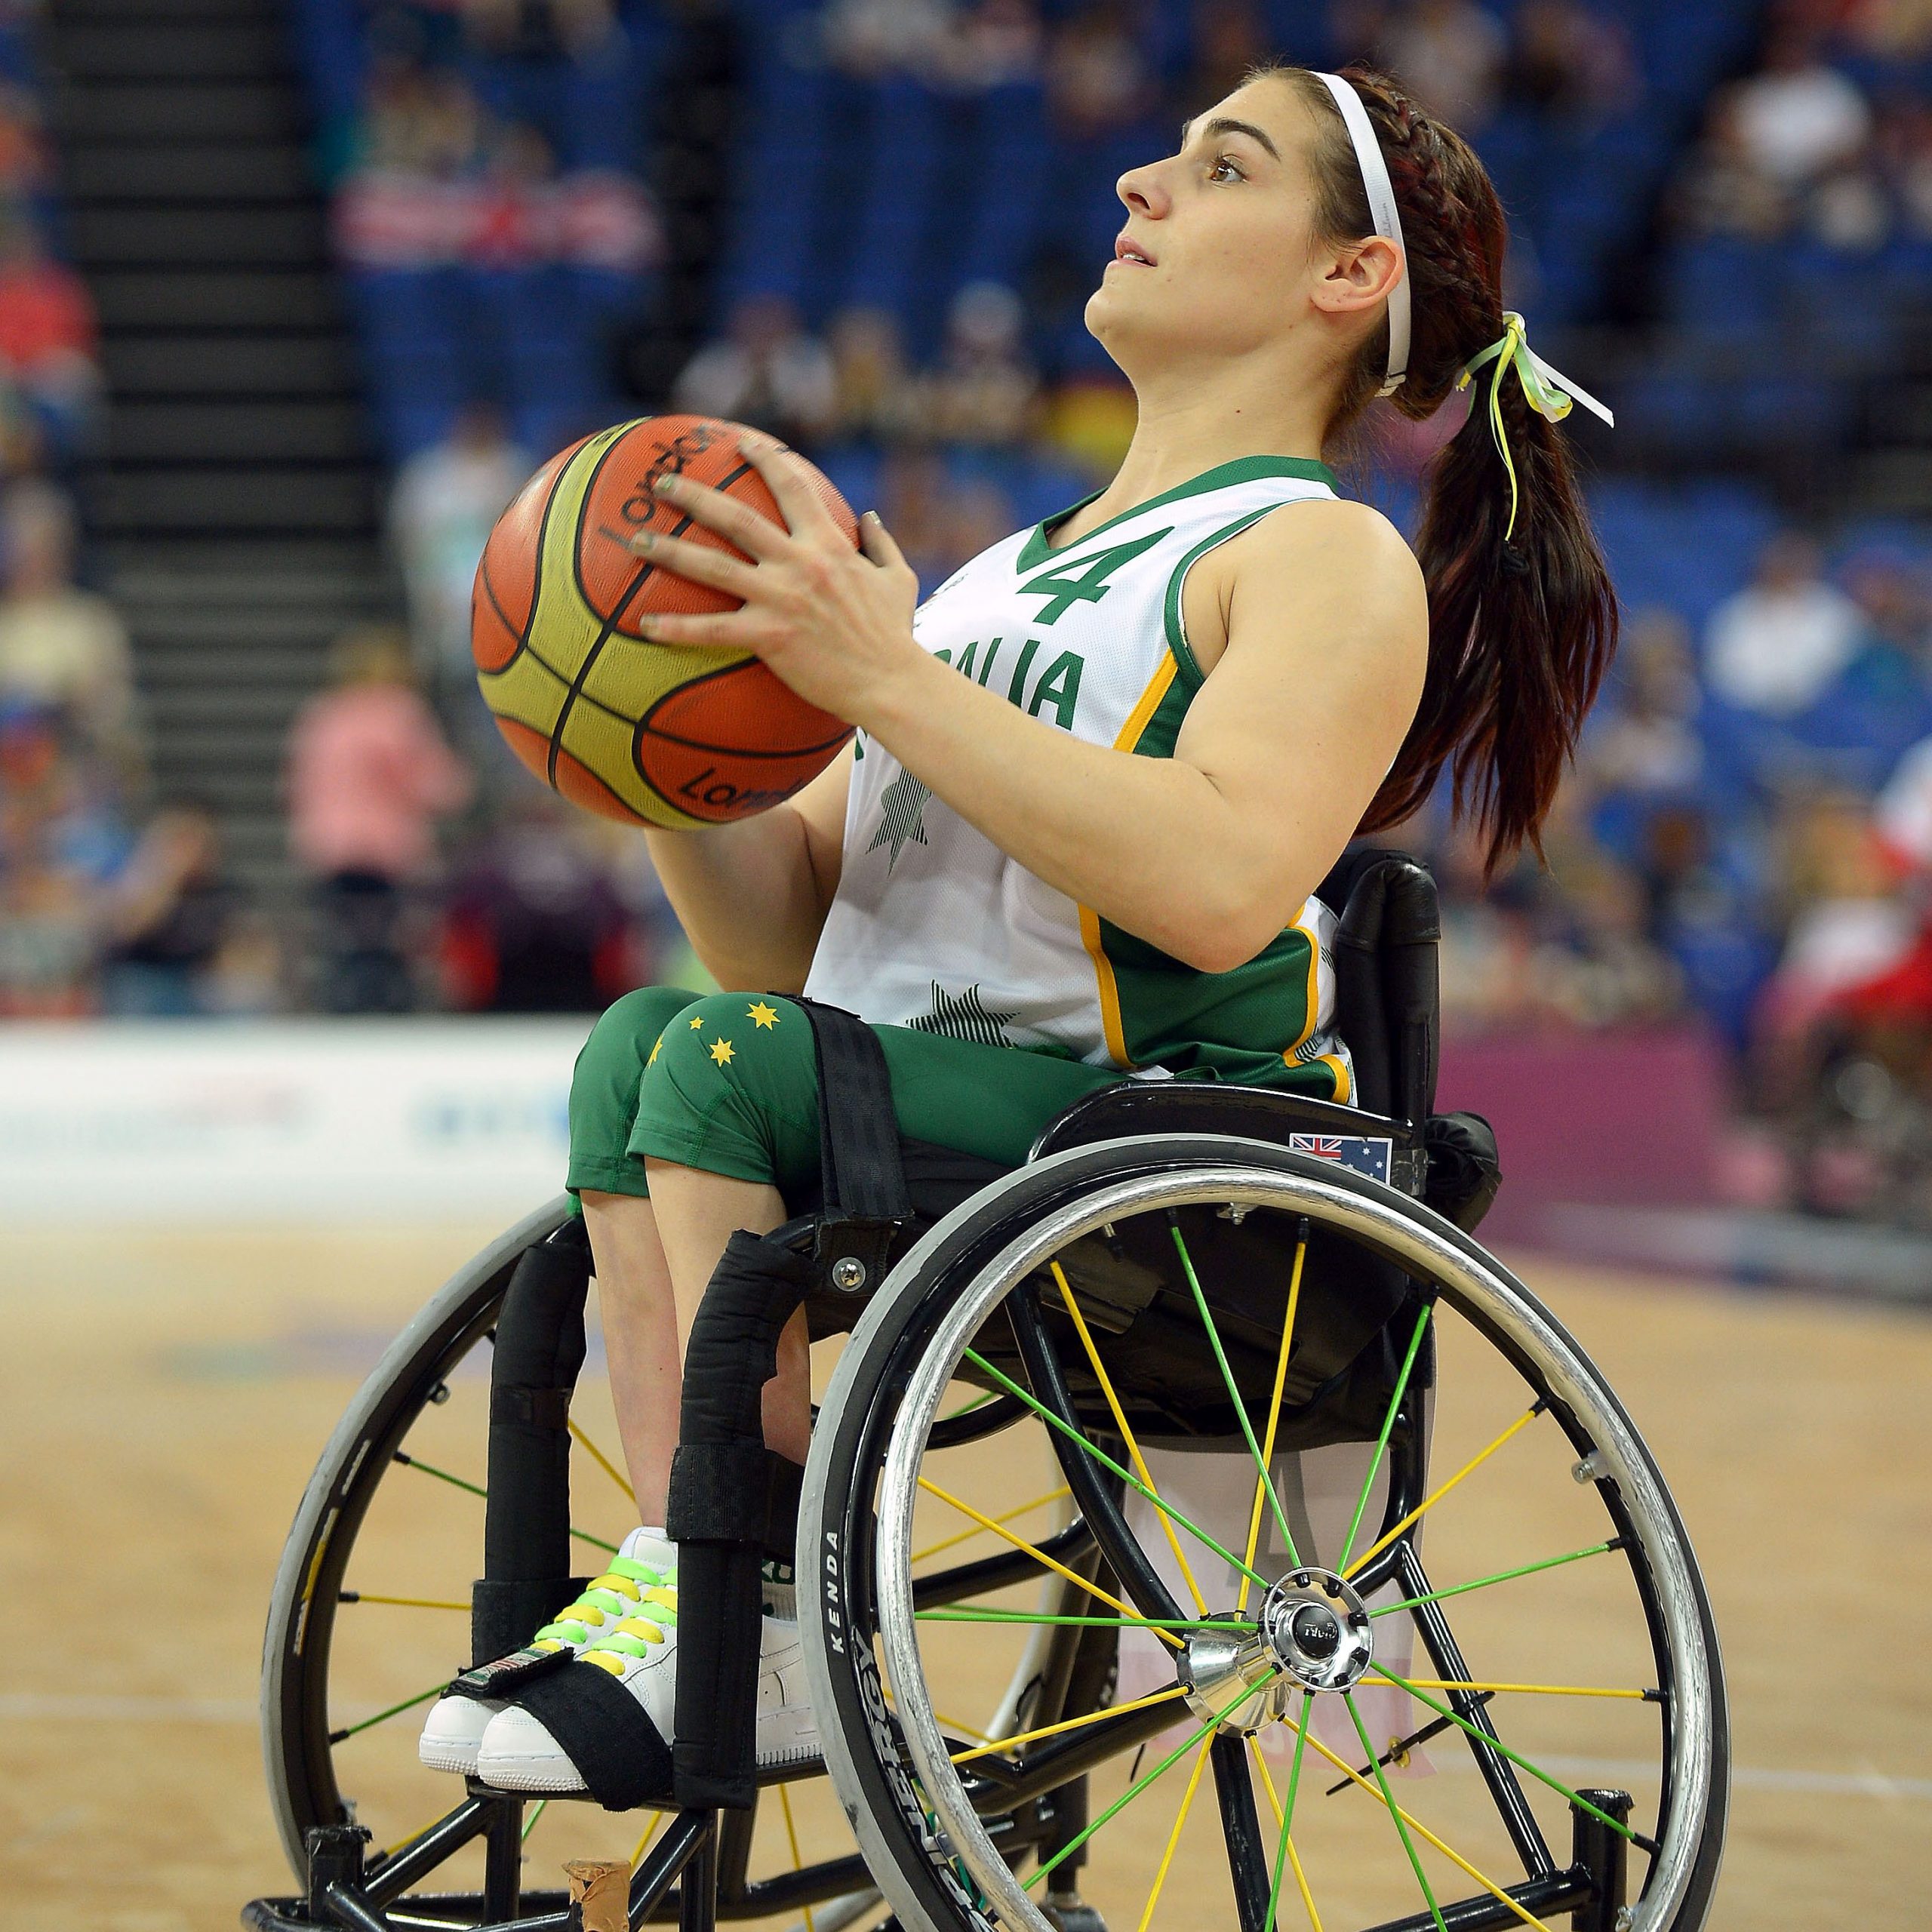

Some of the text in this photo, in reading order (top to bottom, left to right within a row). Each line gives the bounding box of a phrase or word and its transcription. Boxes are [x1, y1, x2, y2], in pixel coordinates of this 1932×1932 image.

[1016, 526, 1175, 626] 4
[933, 637, 1085, 731] ALIA
[826, 1531, 844, 1655] KENDA
